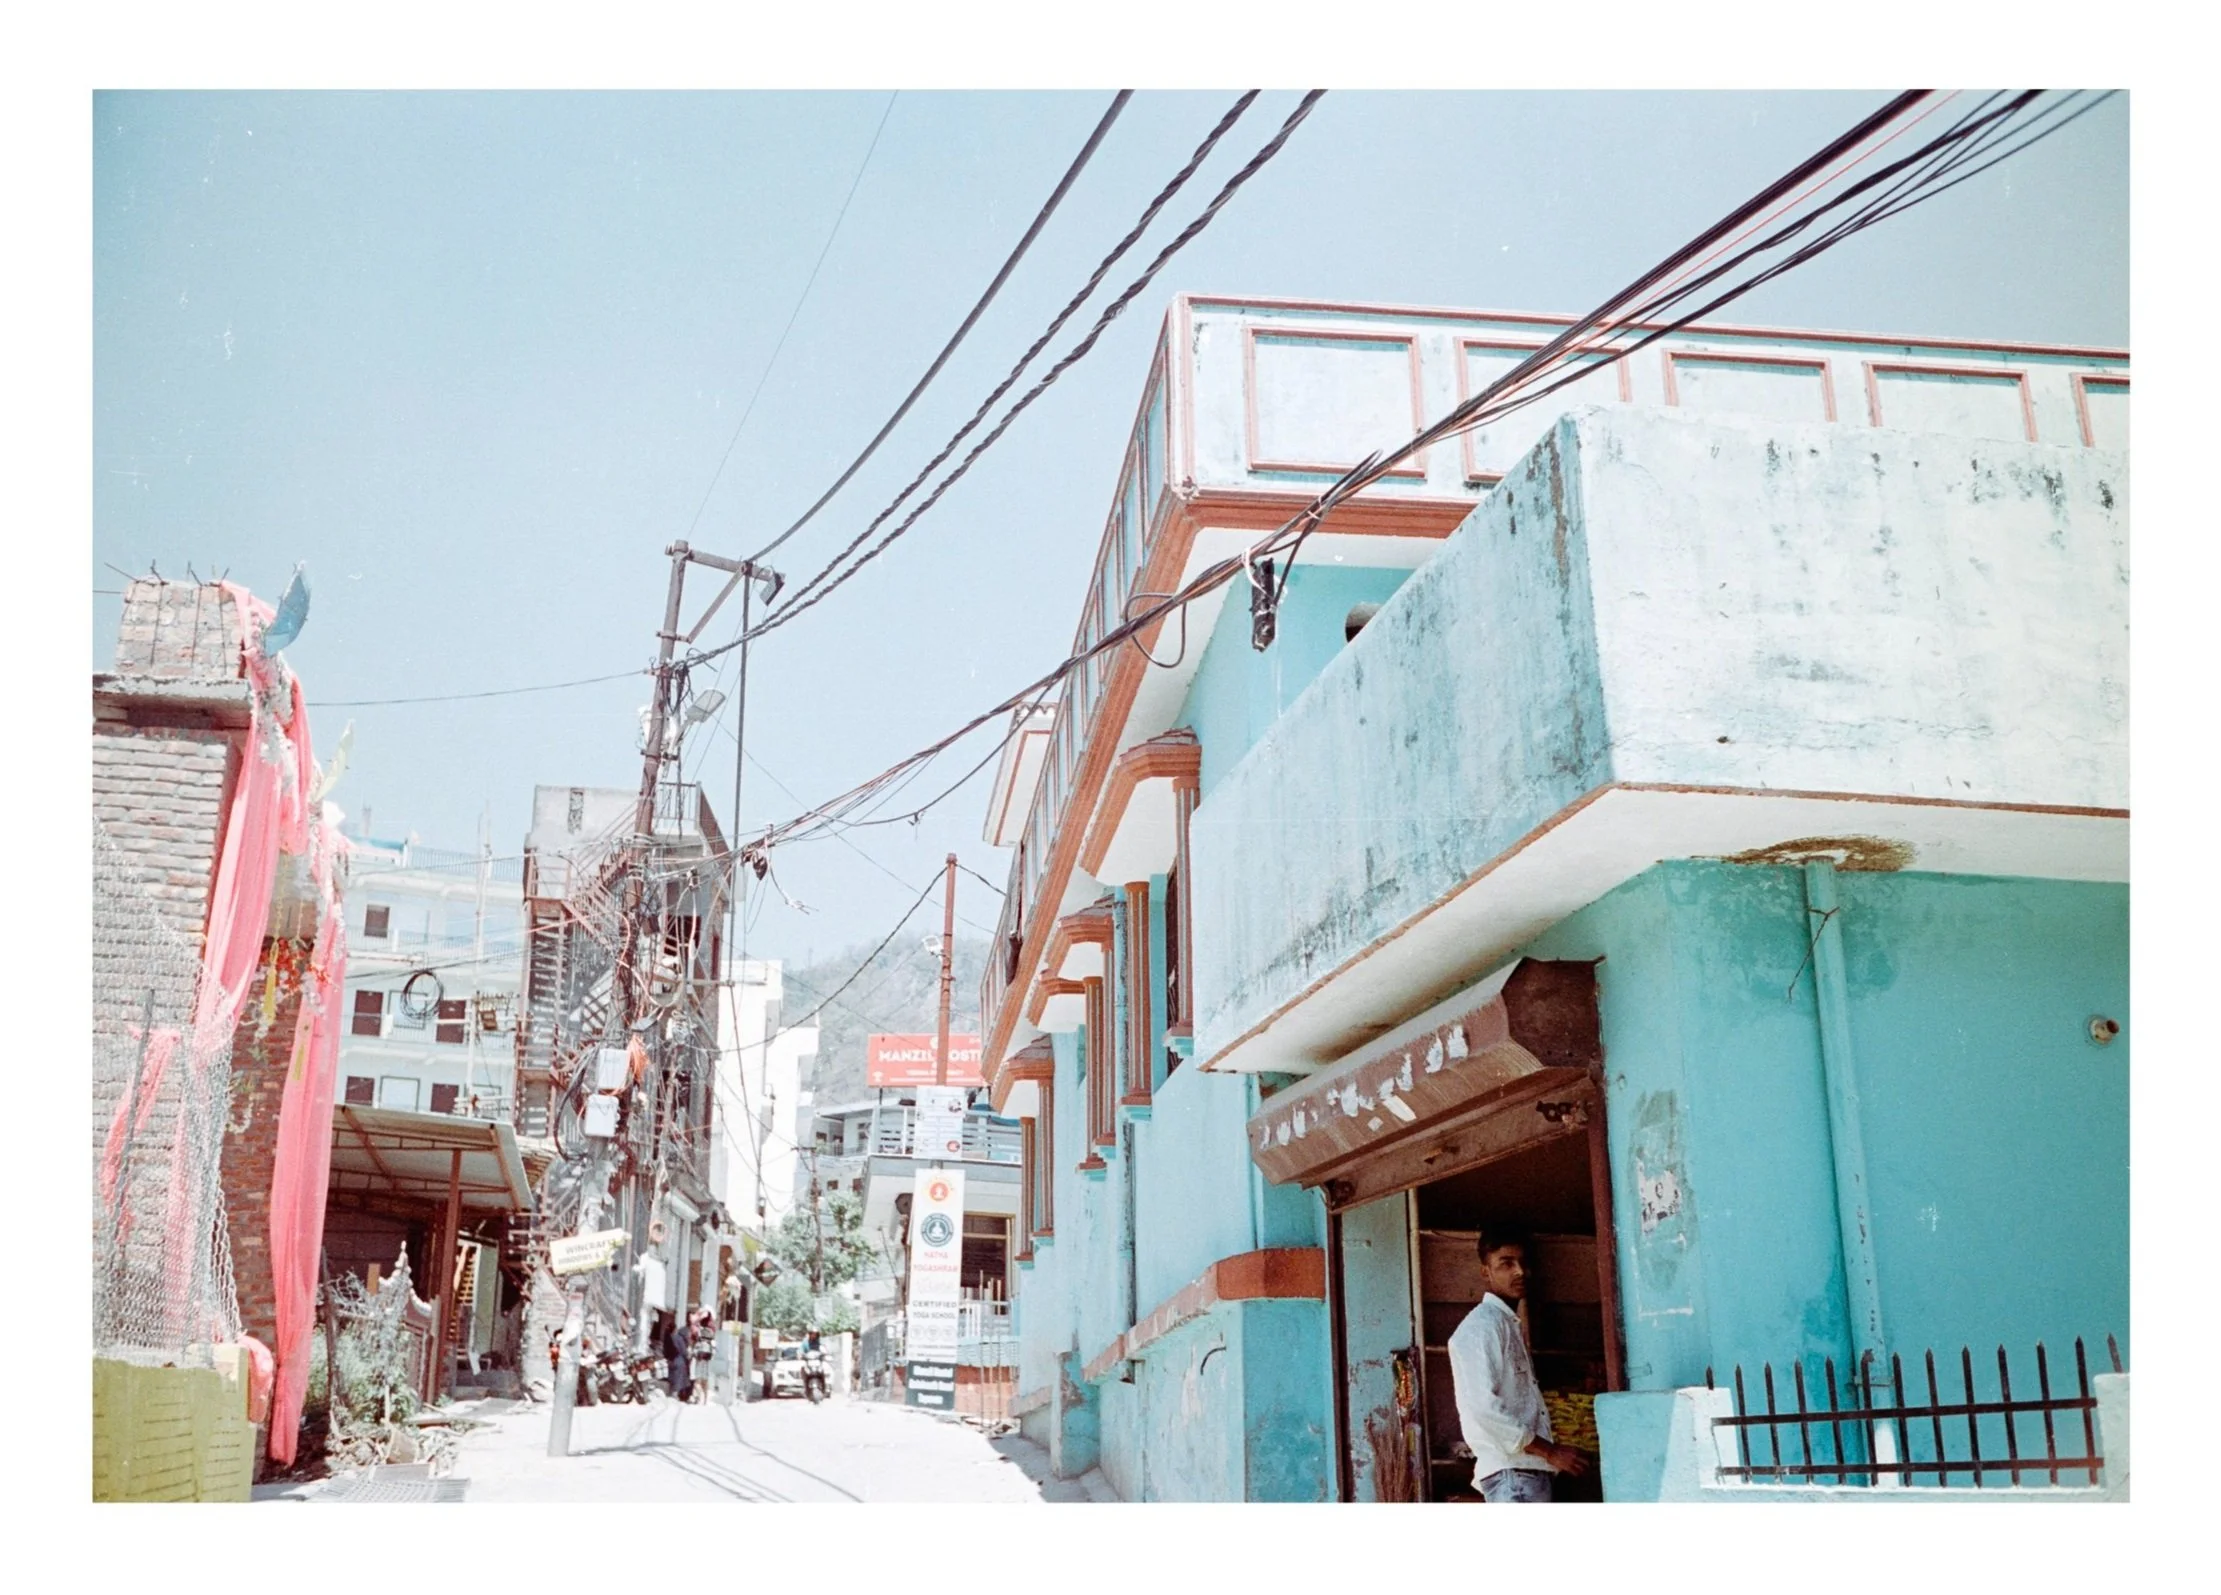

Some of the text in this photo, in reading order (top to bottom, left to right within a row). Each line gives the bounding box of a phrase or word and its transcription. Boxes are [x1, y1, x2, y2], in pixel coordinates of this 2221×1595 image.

[879, 1049, 980, 1062] MANZIL OST
[912, 1300, 957, 1308] CERTIFIED
